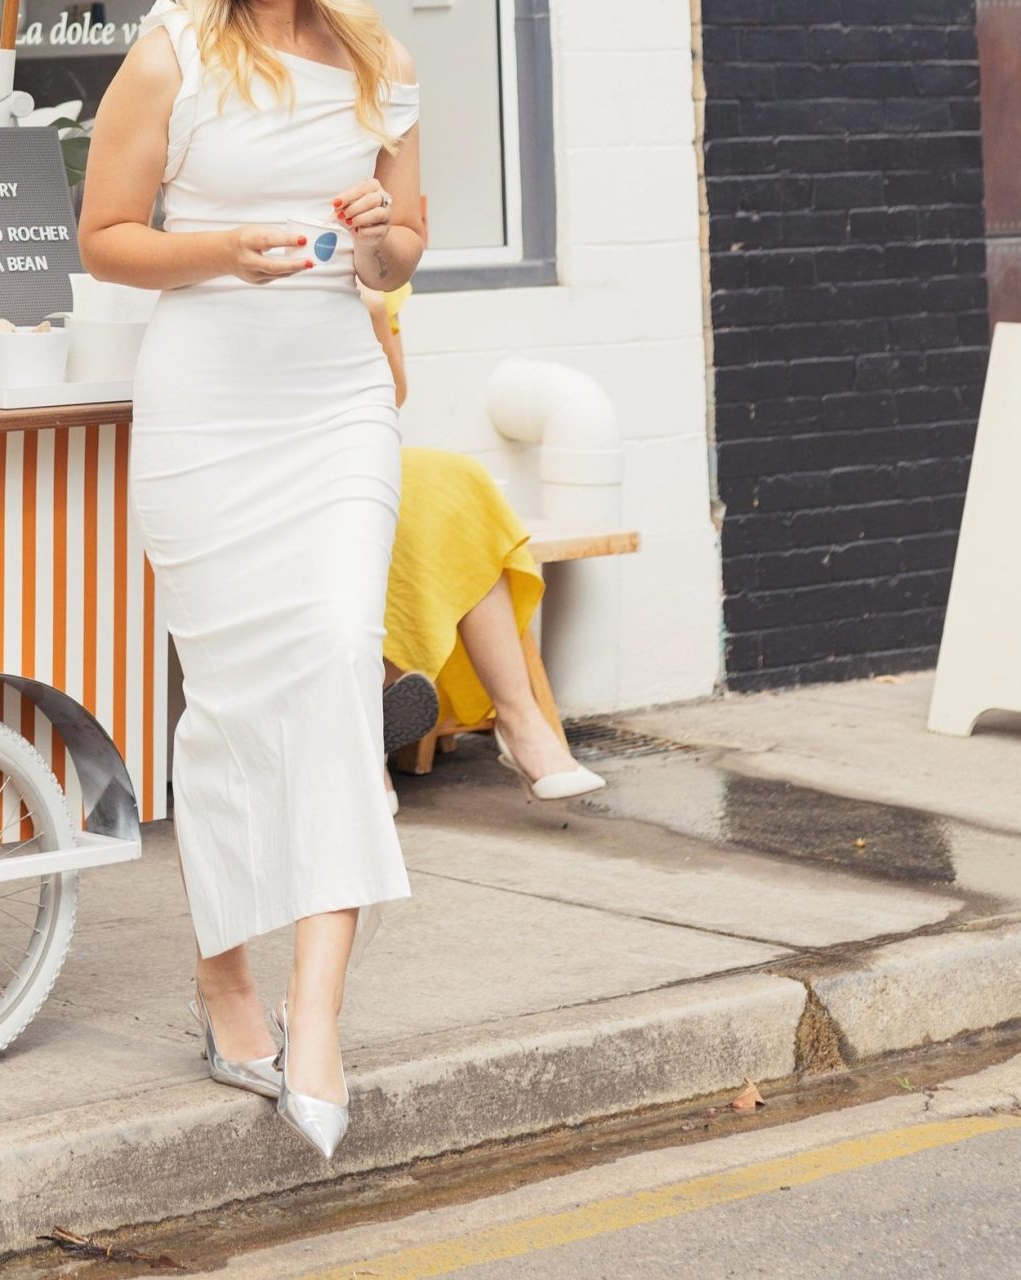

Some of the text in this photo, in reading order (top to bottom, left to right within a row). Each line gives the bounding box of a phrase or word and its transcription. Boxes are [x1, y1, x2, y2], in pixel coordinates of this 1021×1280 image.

[50, 11, 115, 45] dolce
[7, 225, 70, 242] ROCHER
[6, 255, 49, 272] BEAN
